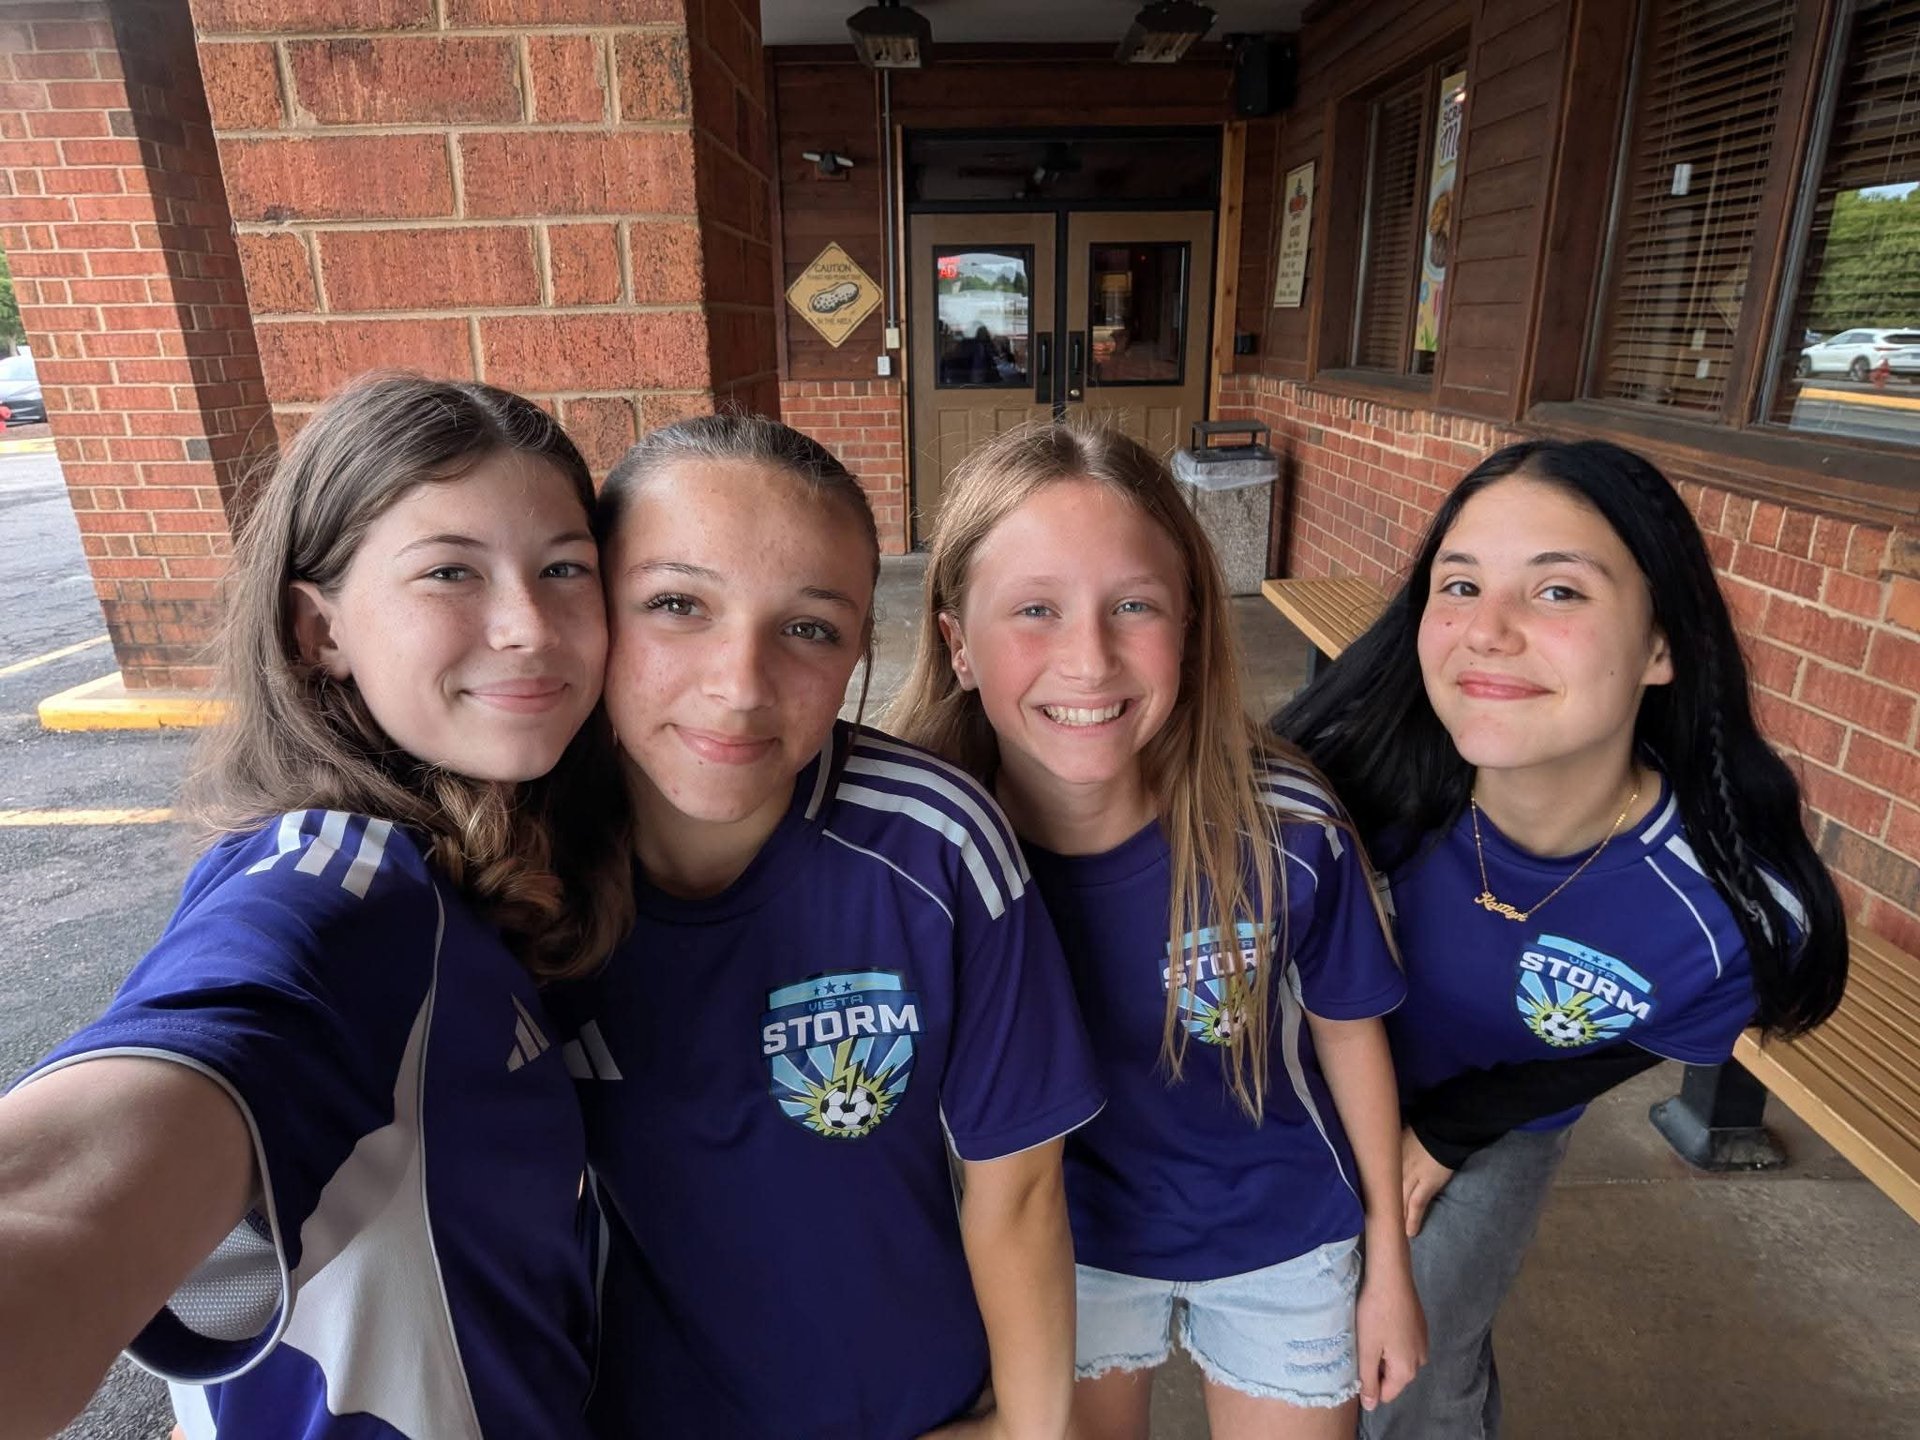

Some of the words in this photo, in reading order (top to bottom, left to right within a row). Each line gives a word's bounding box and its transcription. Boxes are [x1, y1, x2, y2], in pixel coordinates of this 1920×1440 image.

[814, 264, 852, 273] CAUTION
[1163, 934, 1276, 989] STOR
[1568, 955, 1618, 981] VISTA
[808, 994, 863, 1012] VISTA
[1519, 951, 1651, 1021] STORM
[763, 1004, 919, 1055] STORM
